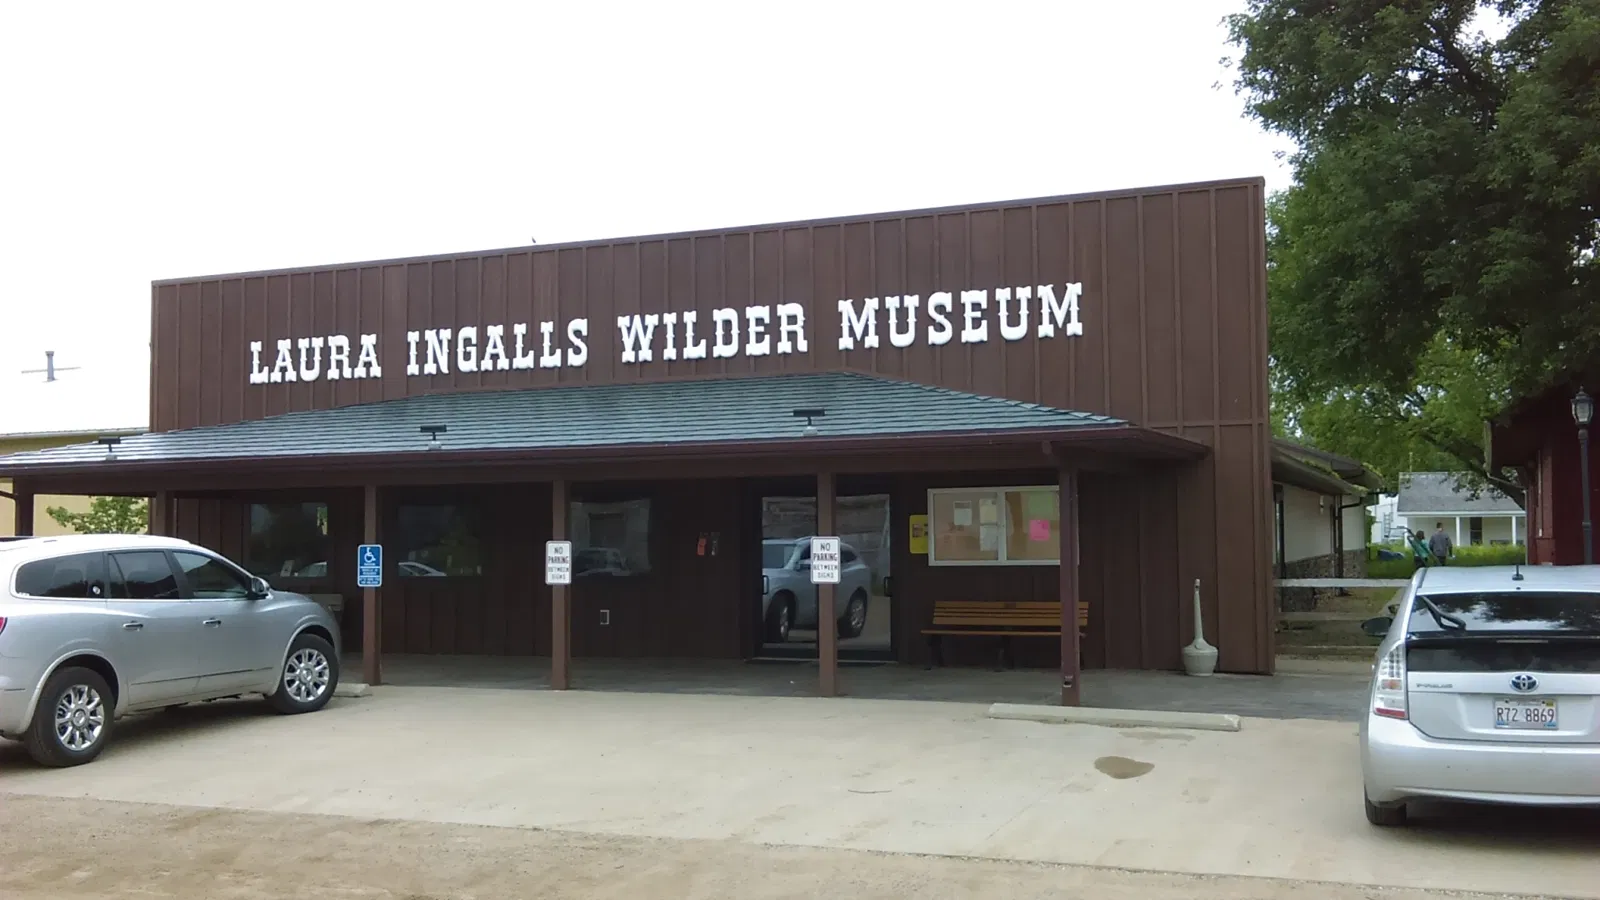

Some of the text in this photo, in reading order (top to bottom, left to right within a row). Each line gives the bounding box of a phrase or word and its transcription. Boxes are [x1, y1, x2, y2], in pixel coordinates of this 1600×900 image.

[249, 281, 1083, 384] LAURA INGALLS WILDER MUSEUM
[554, 546, 563, 555] NO
[820, 542, 831, 551] NO
[813, 552, 838, 561] PARKING
[1496, 707, 1555, 723] R72 8869
